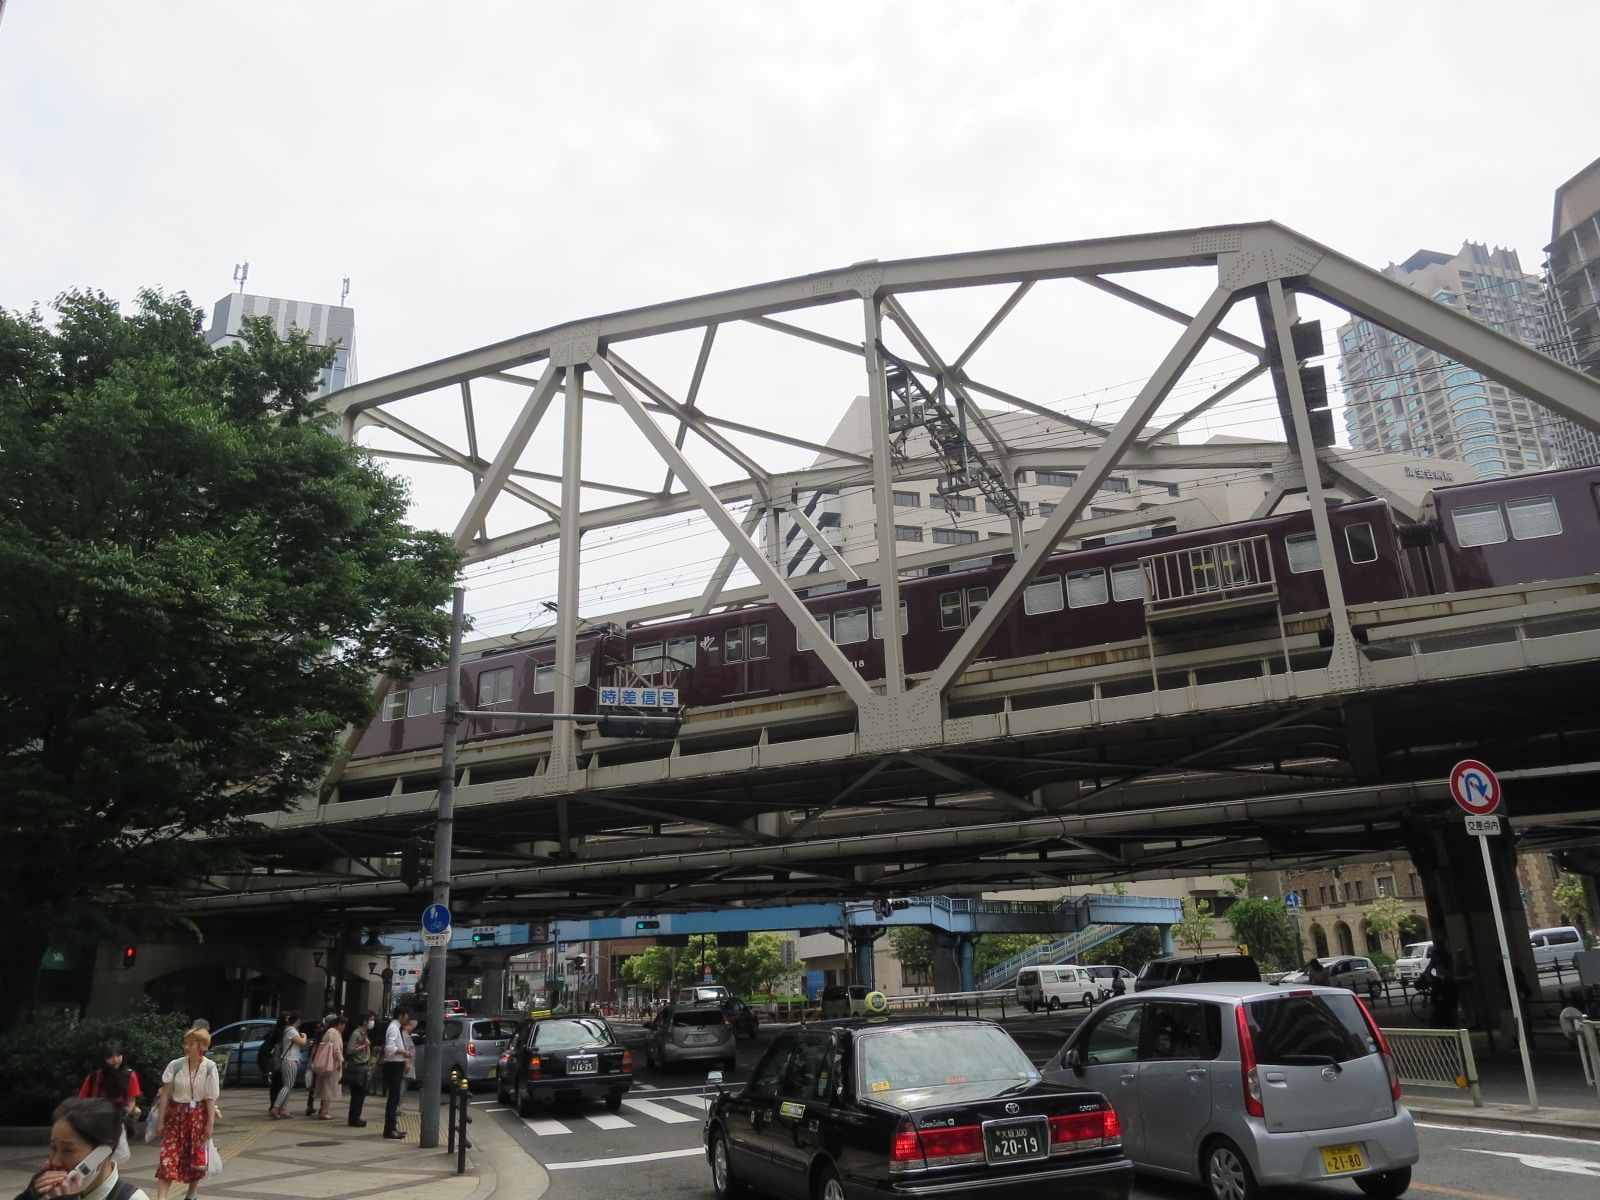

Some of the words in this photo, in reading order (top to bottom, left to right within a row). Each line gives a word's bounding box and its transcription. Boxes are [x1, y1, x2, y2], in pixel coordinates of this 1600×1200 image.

[602, 690, 675, 705] 時差信号
[1468, 821, 1498, 831] 交差点内
[1001, 1137, 1038, 1156] 20-19
[1332, 1153, 1361, 1170] 21-80
